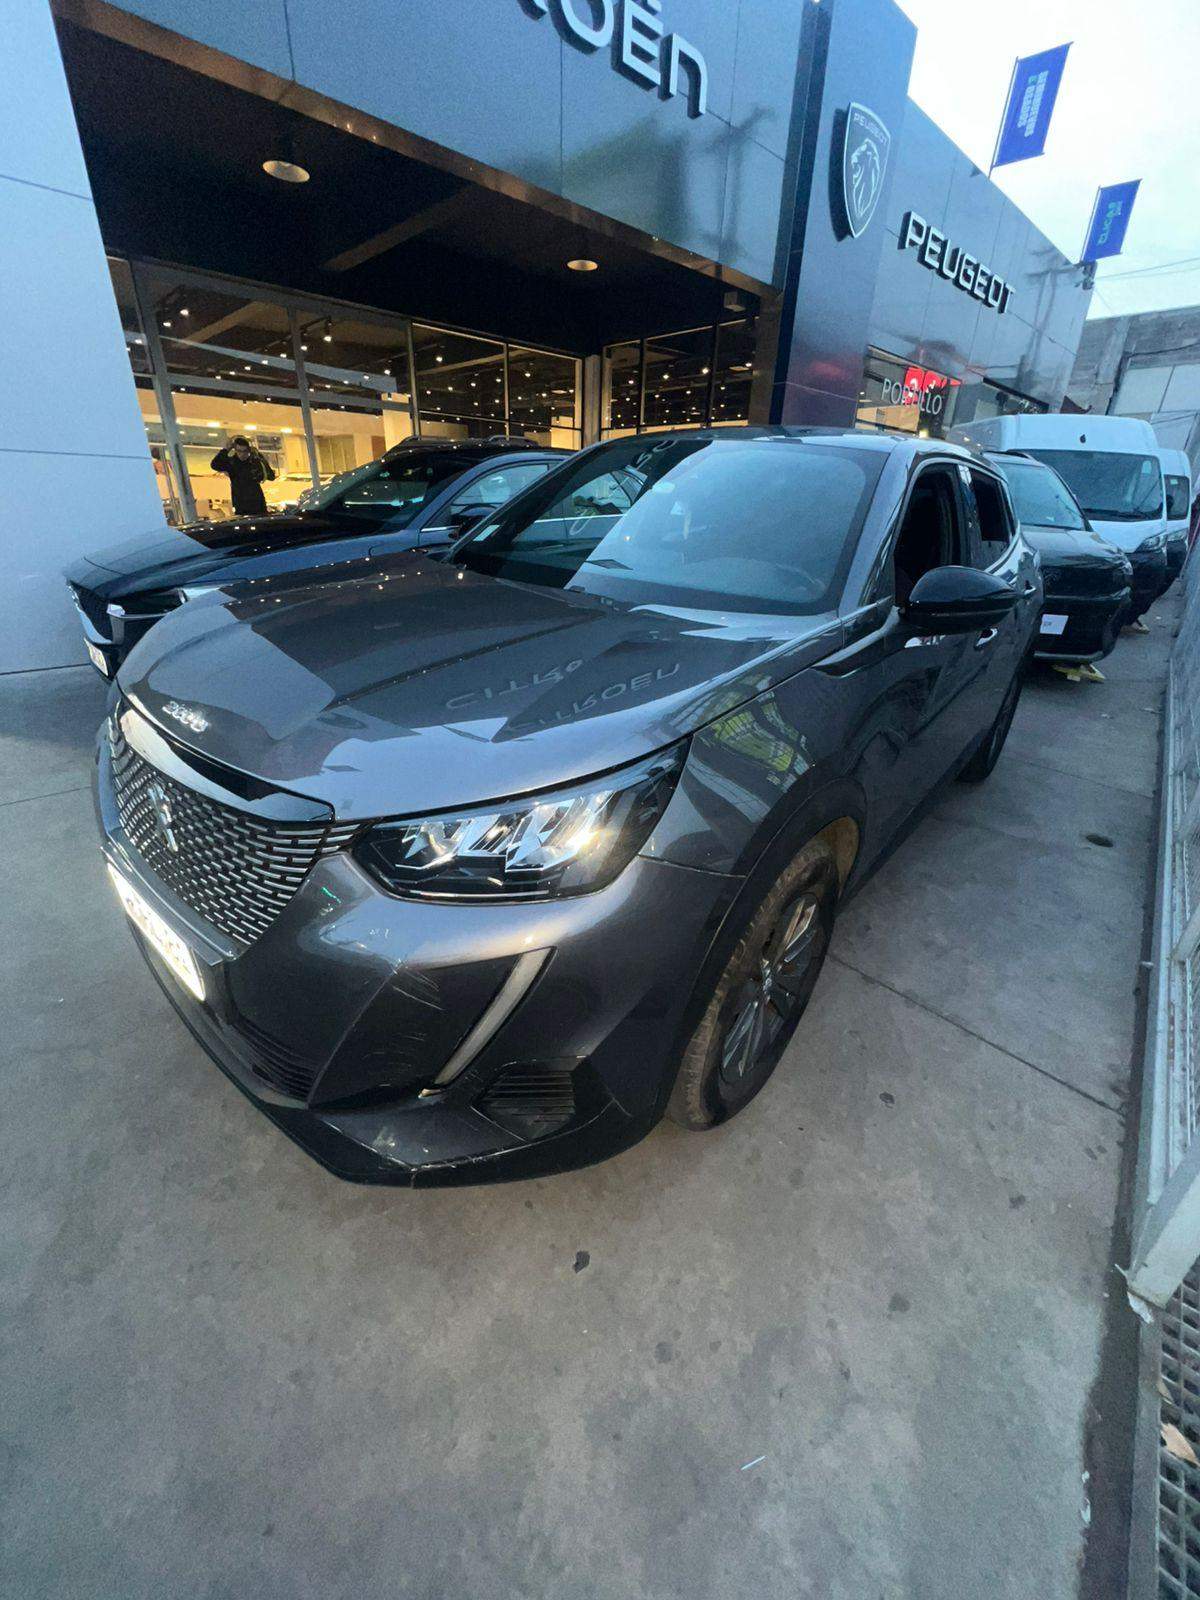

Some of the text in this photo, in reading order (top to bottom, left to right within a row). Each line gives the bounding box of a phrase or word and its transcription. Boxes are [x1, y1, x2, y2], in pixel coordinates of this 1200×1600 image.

[900, 211, 1016, 313] PEUGEOT
[881, 378, 942, 415] PORTILLO
[162, 700, 209, 732] 2008
